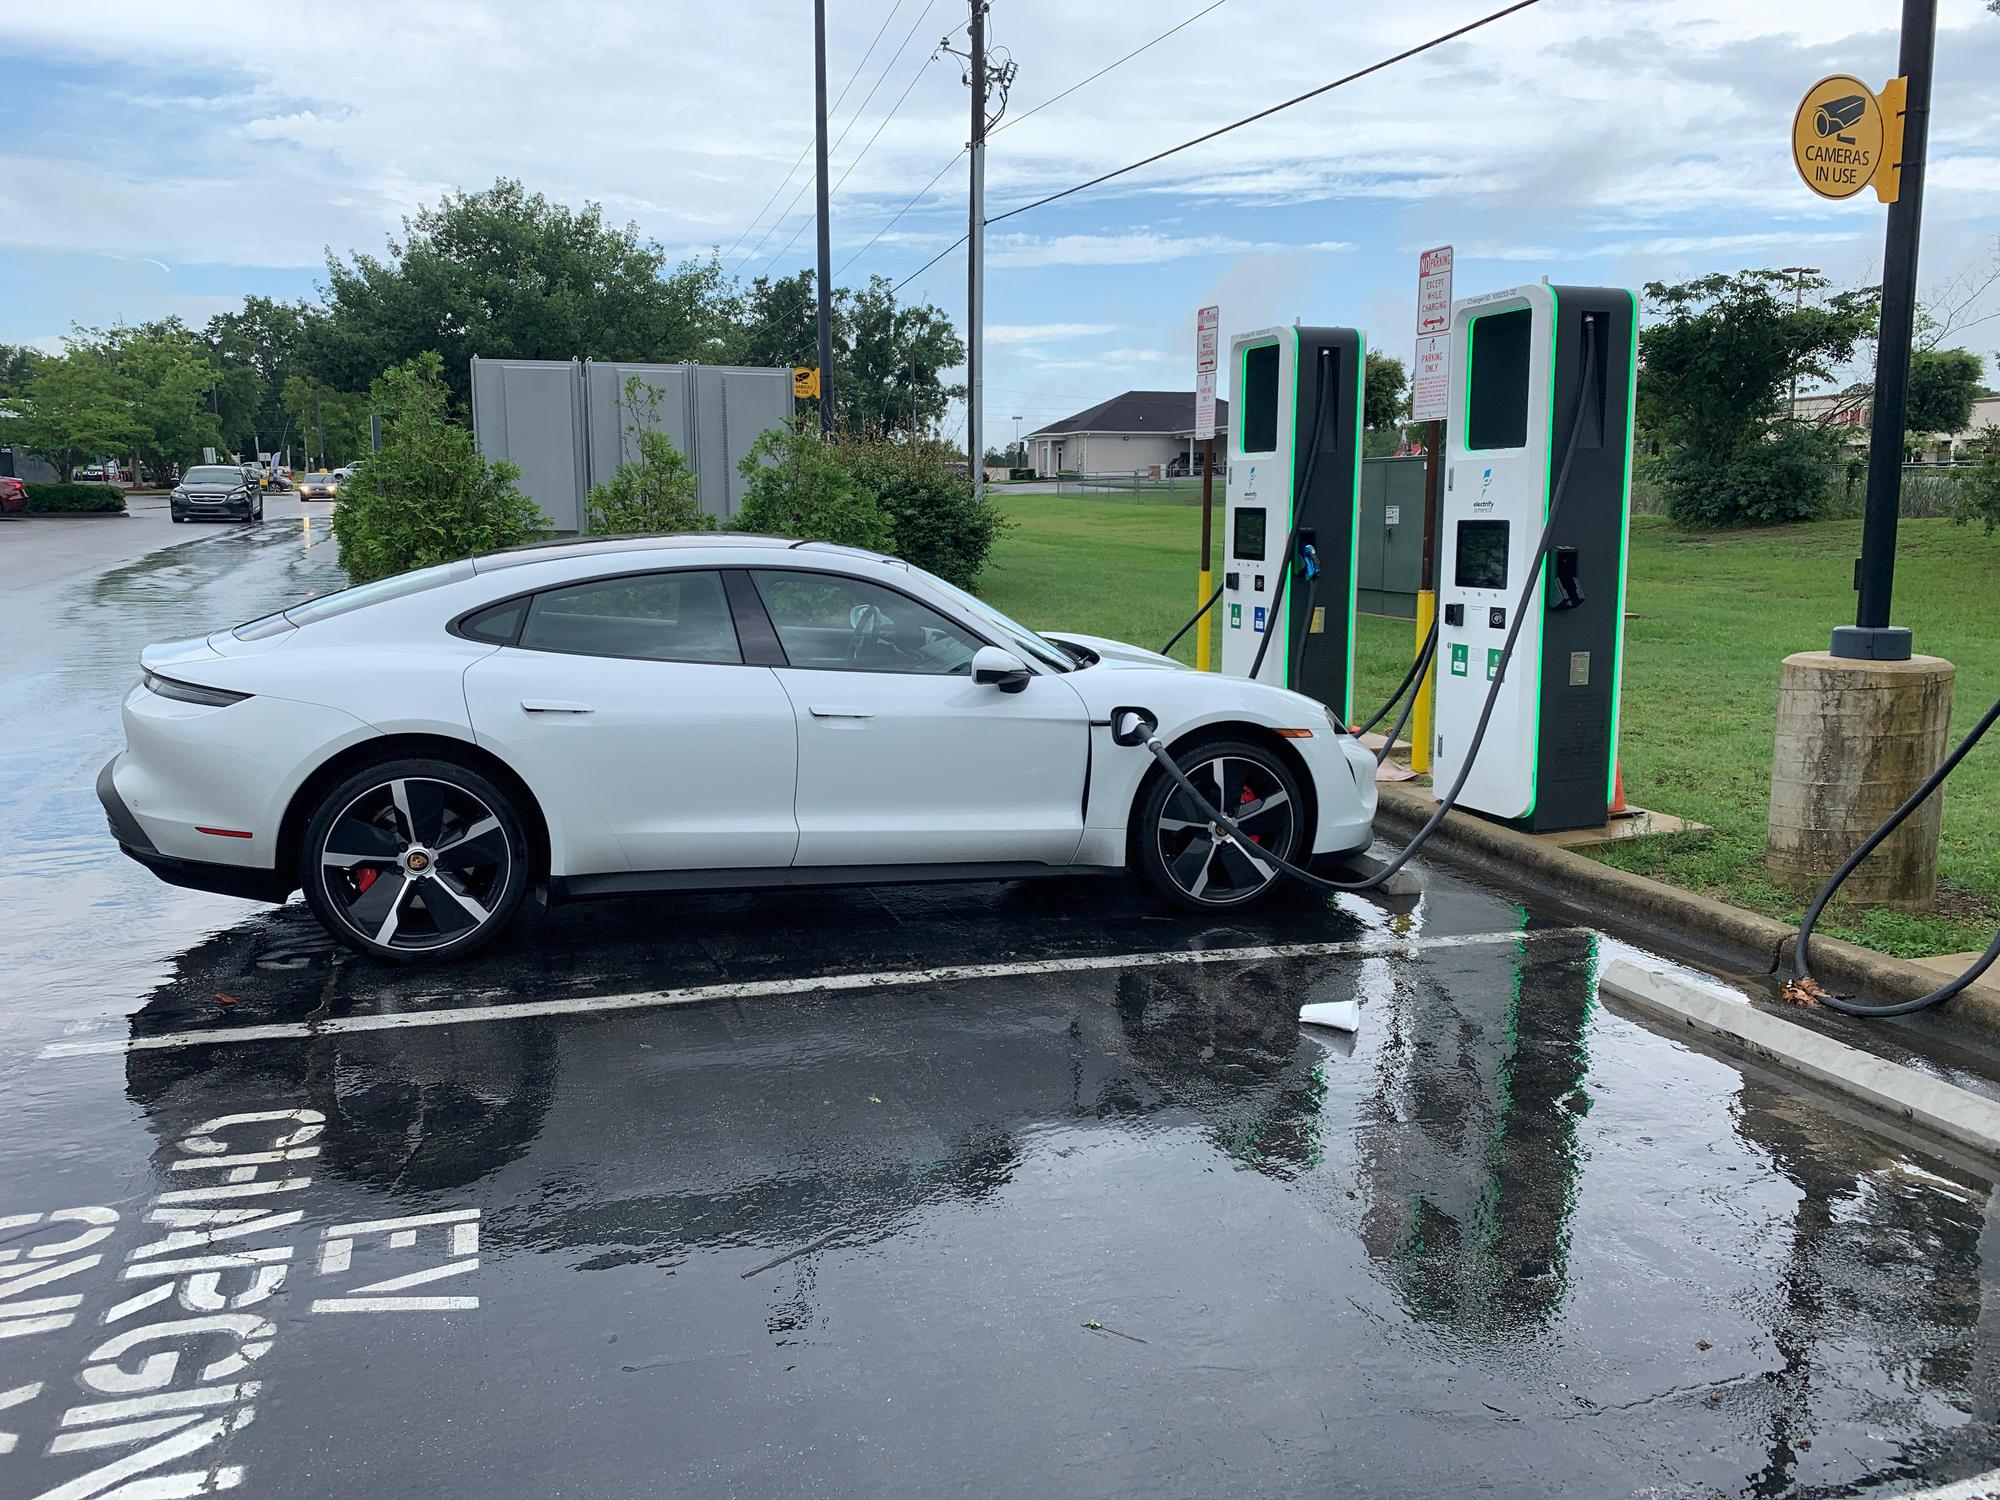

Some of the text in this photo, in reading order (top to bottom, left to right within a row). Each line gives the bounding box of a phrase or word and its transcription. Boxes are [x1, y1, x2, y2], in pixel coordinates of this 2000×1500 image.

[1805, 145, 1870, 166] CAMERAS
[1815, 166, 1857, 184] IN USE
[1421, 256, 1430, 273] NO
[1426, 278, 1444, 289] EXCEPT
[1421, 352, 1443, 363] PARKING
[1473, 500, 1494, 509] electrify
[312, 1208, 481, 1313] EV
